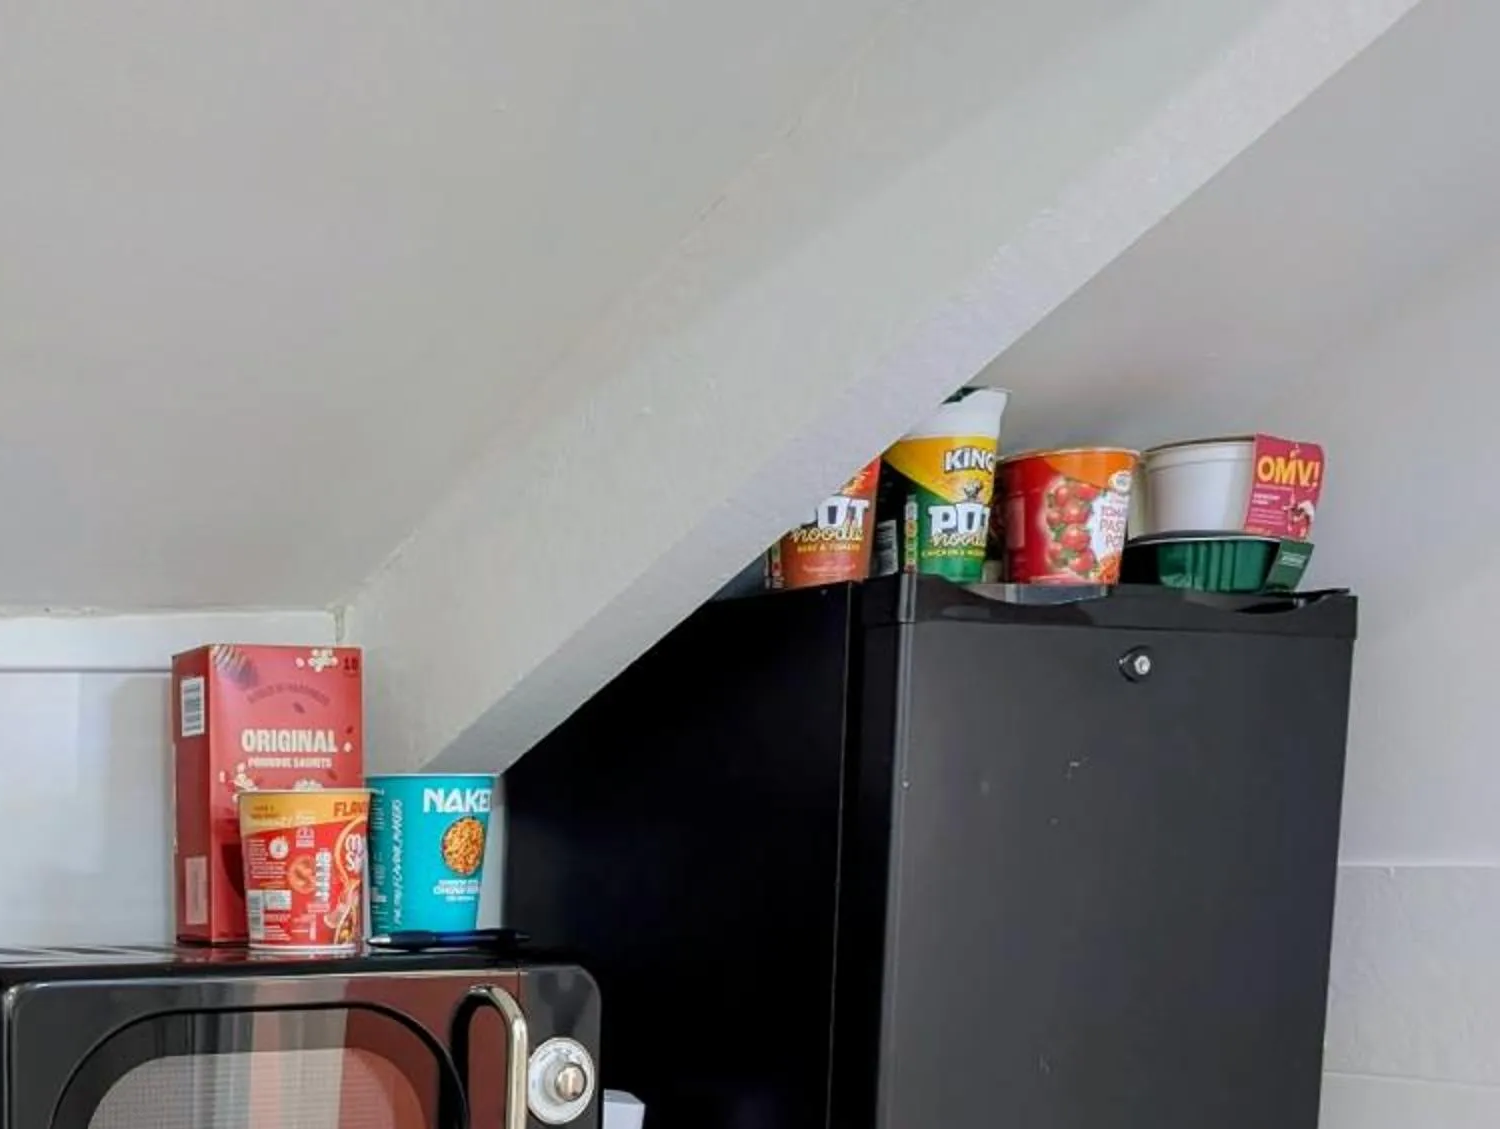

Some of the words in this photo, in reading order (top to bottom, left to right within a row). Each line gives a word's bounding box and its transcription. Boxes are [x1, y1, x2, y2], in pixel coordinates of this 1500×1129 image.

[1257, 455, 1321, 487] OMV!
[816, 495, 871, 529] OT
[241, 728, 338, 753] ORIGINAL
[422, 788, 490, 813] NAKE
